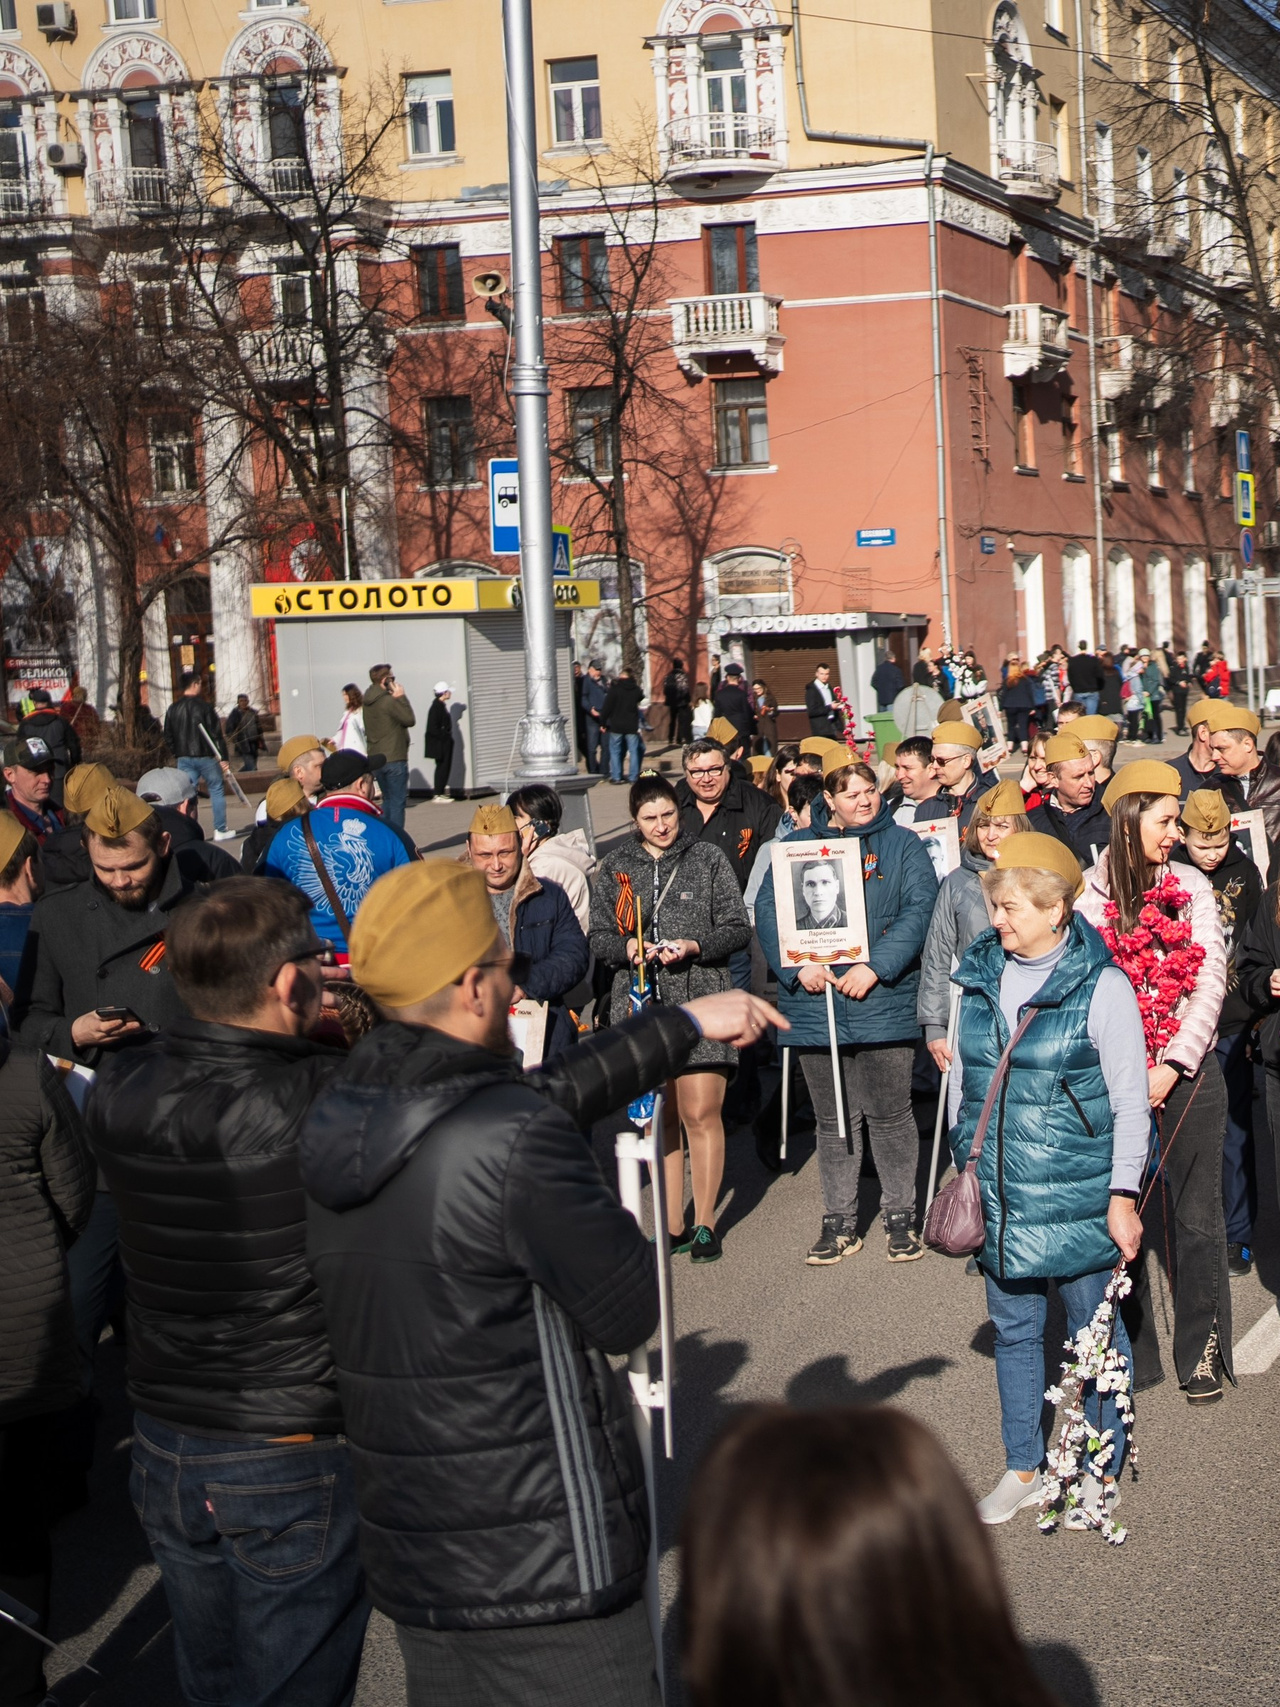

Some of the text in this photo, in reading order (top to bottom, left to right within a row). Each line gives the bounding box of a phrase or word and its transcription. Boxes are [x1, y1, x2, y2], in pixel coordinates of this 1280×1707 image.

[296, 584, 453, 611] СТОЛОТО
[731, 615, 858, 635] МОРОЖЕНОЕ
[819, 937, 847, 945] Петрович
